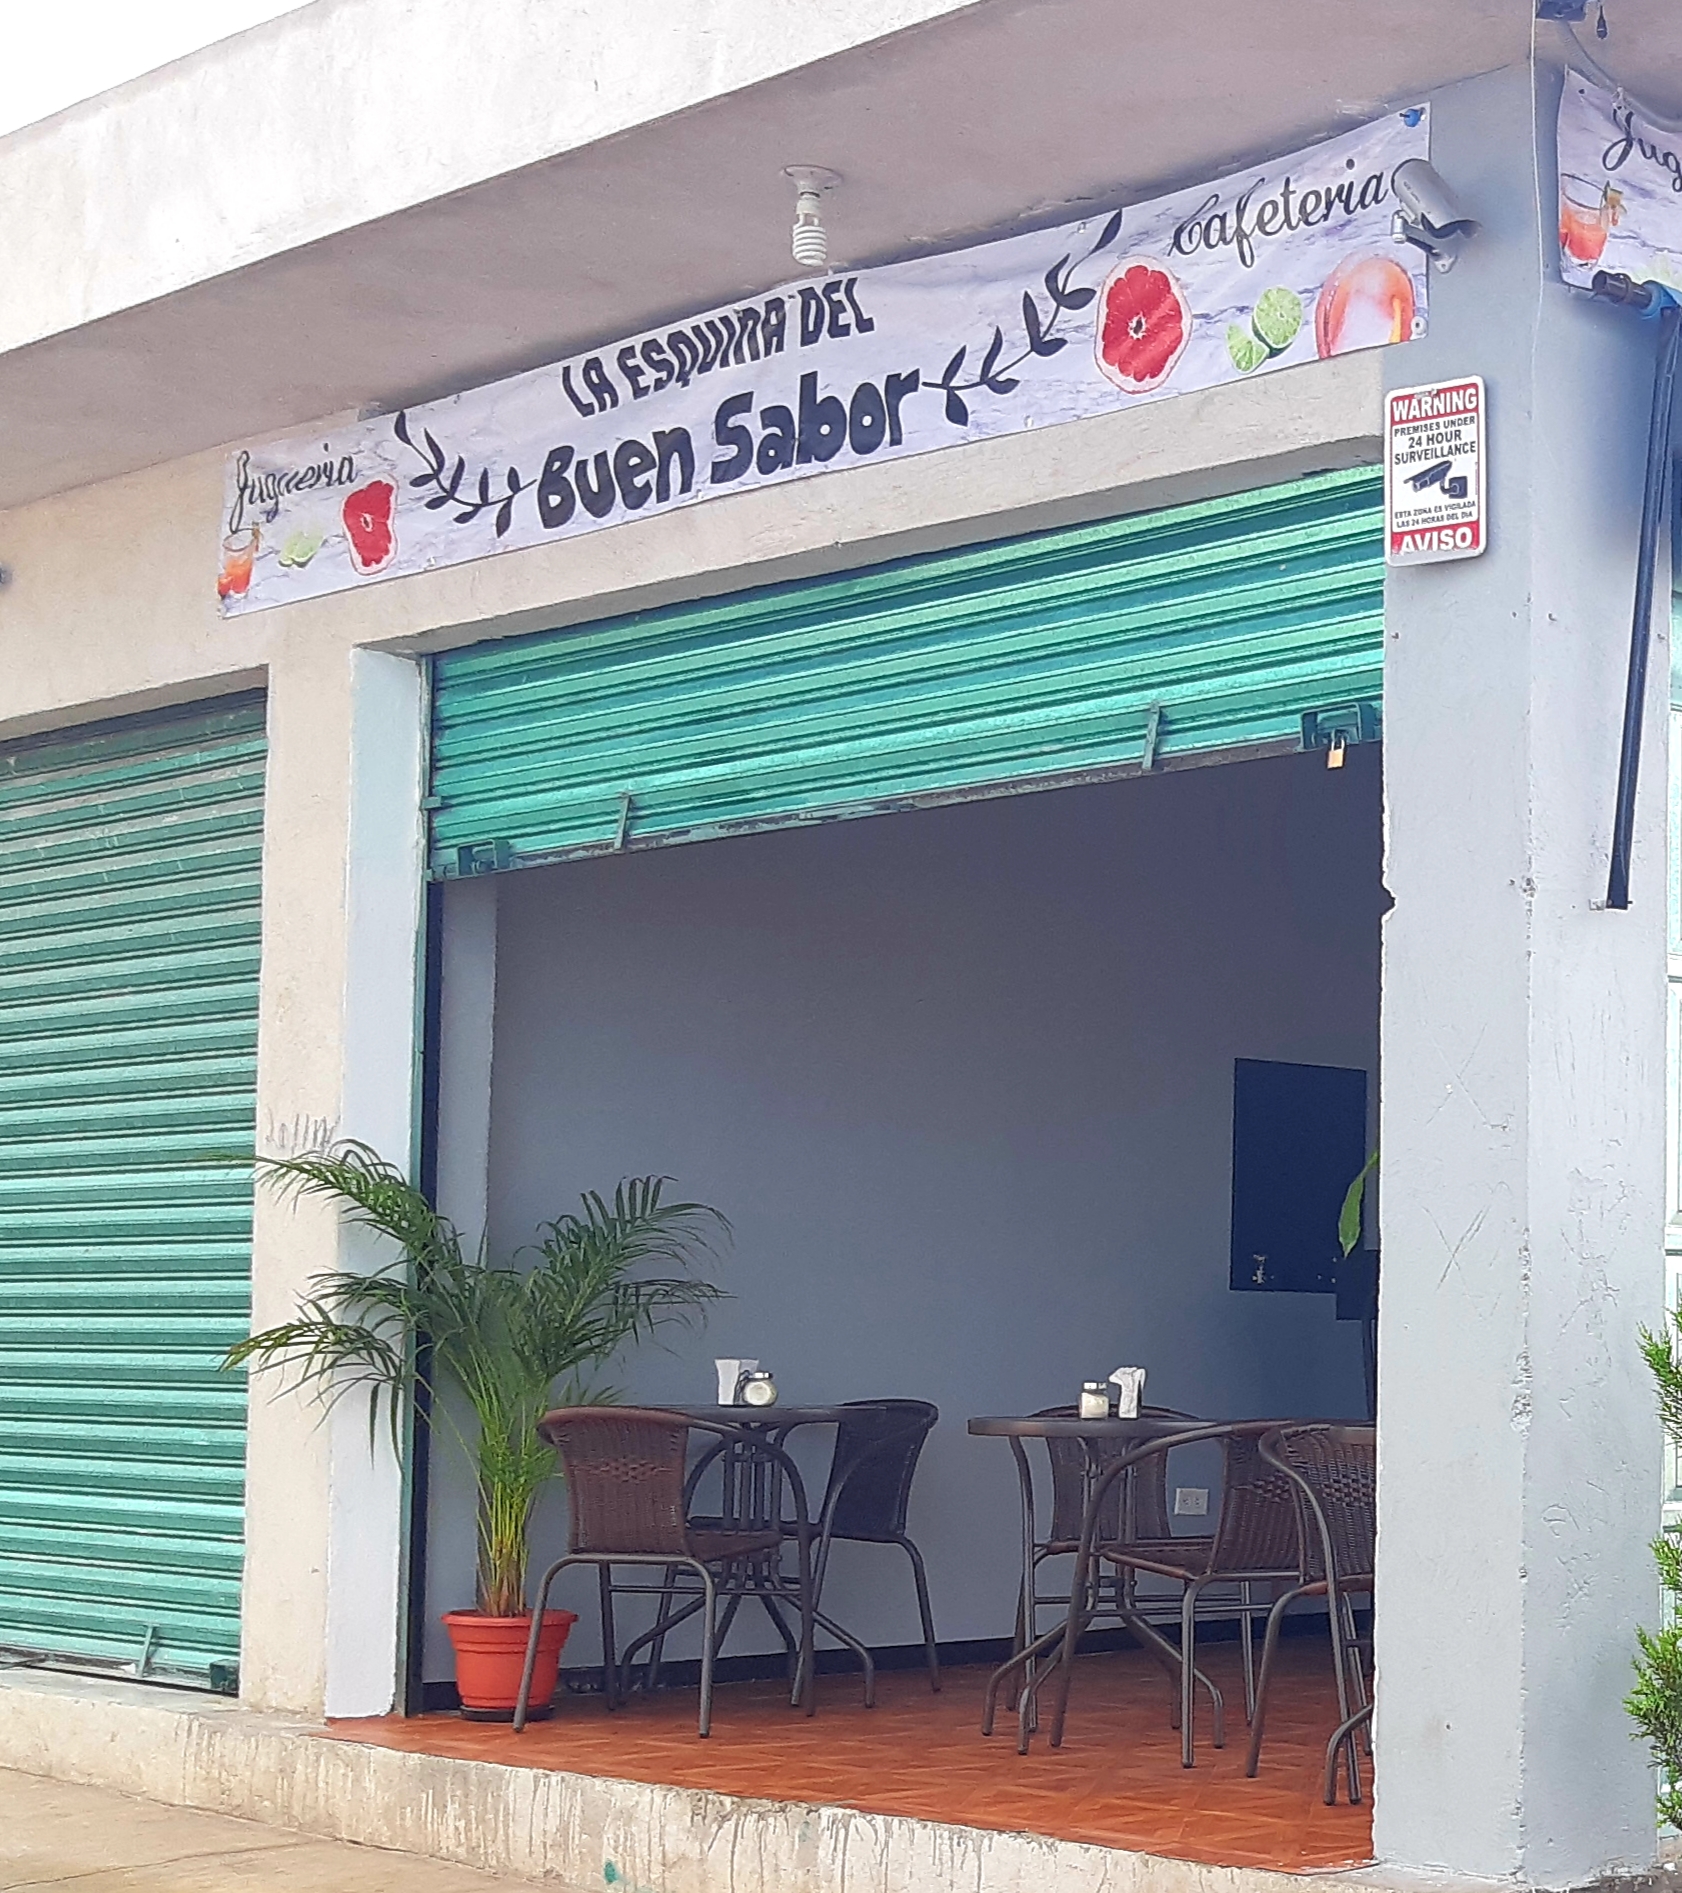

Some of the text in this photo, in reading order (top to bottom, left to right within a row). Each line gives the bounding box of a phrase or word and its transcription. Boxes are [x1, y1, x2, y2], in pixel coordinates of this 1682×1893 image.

[562, 277, 875, 417] LA ESQUINA DEL
[1392, 388, 1478, 421] WARNING
[1394, 416, 1475, 437] PREMISES UNDER
[537, 368, 920, 529] Buen Sabor
[1408, 430, 1462, 449] 24 HOUR
[1394, 441, 1476, 465] SURVEILLANCE
[1394, 500, 1476, 519] ESTA ZONA ES VIGILADA
[1396, 520, 1410, 528] LAS
[1421, 514, 1444, 524] HORAS
[1446, 513, 1459, 521] DEL
[1400, 526, 1473, 555] AVISO
